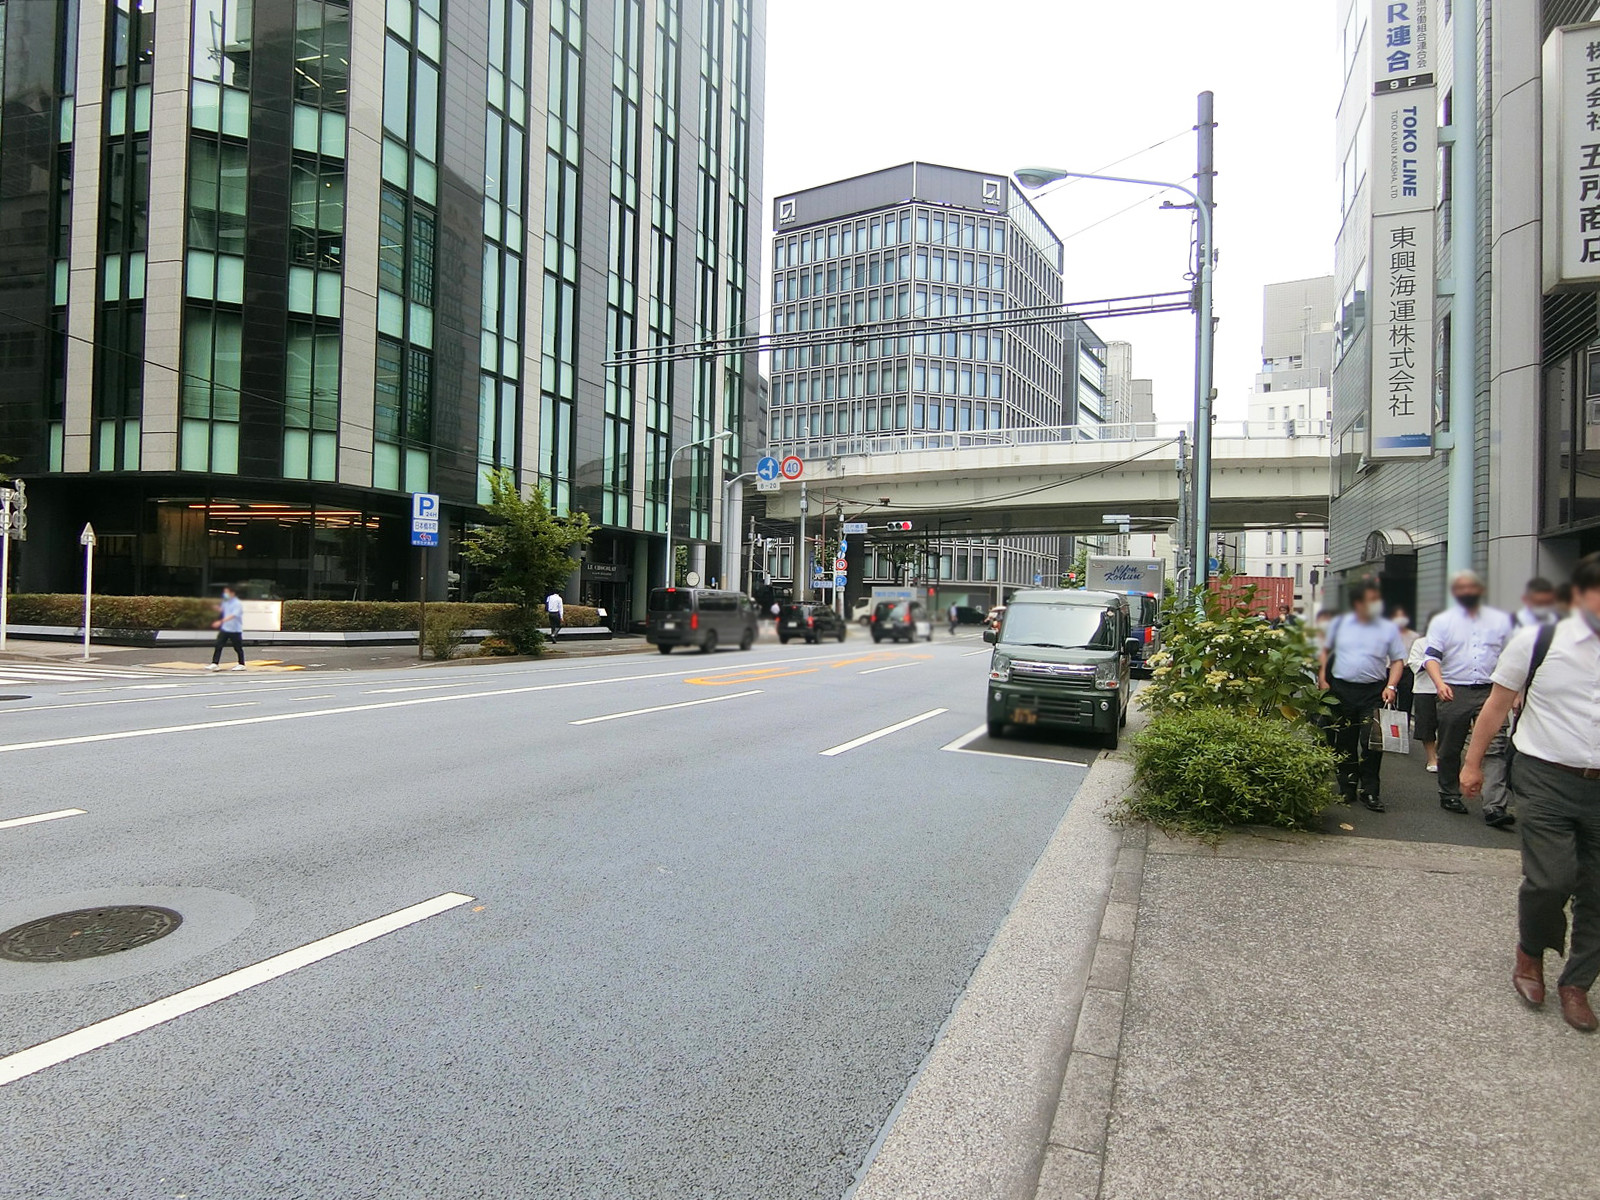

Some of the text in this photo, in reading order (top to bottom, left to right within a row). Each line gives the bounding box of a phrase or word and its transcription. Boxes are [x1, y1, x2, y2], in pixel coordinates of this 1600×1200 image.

[1391, 110, 1399, 130] TOKO
[1390, 131, 1399, 154] KAIUN
[1403, 106, 1417, 197] TOKO LINE
[1388, 226, 1416, 417] 東興海運株式会社
[786, 462, 798, 473] 40
[419, 496, 434, 516] P
